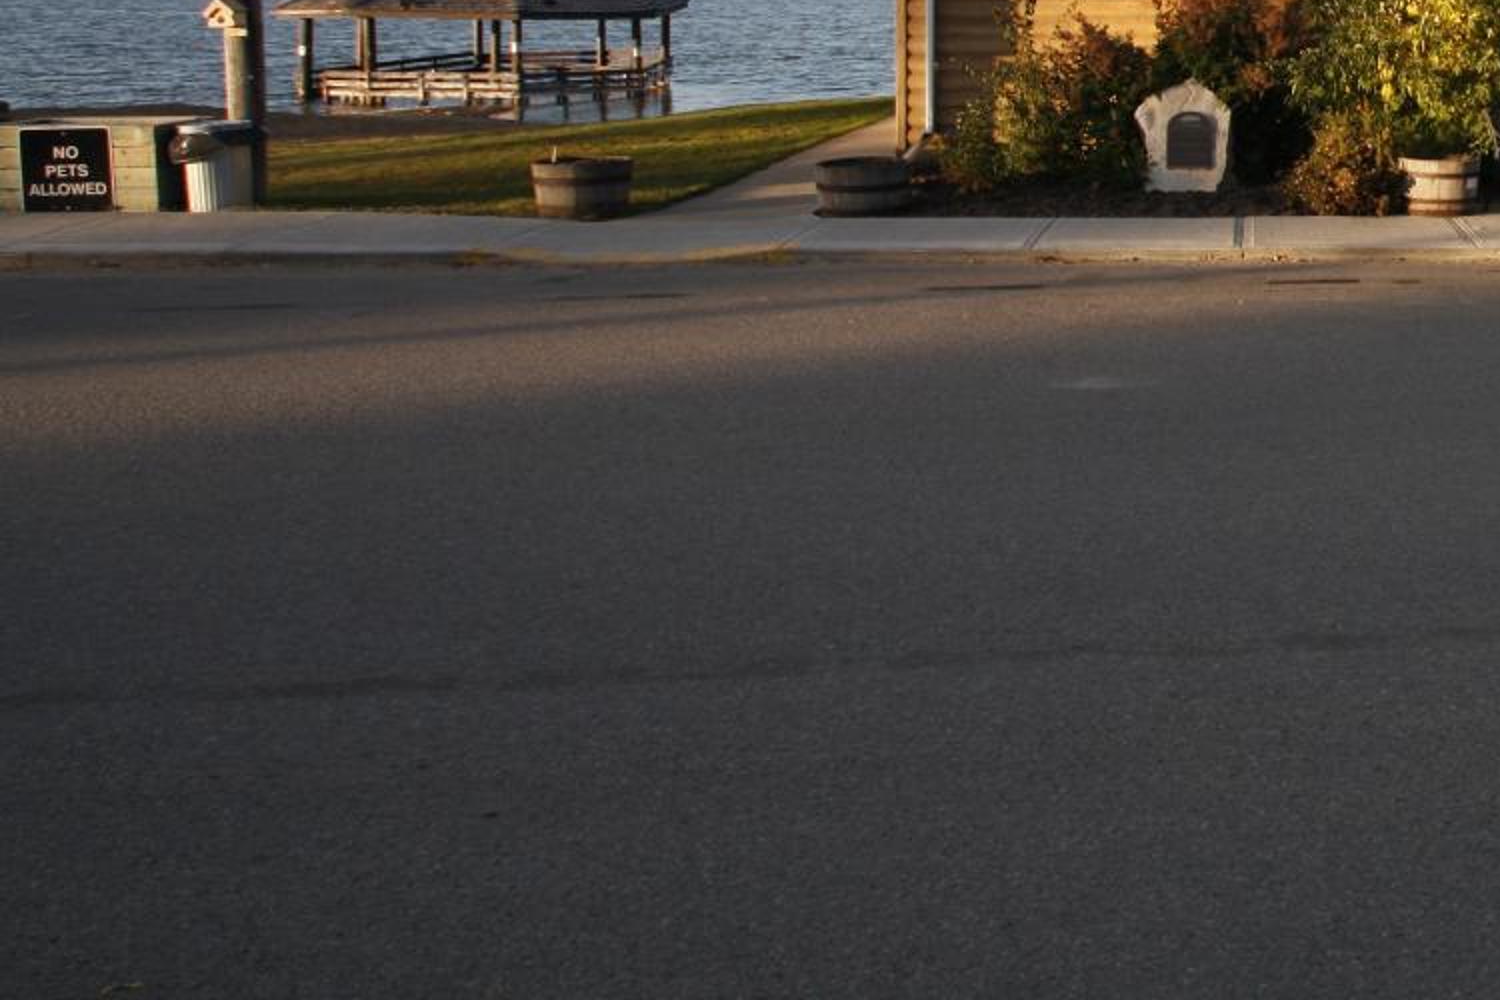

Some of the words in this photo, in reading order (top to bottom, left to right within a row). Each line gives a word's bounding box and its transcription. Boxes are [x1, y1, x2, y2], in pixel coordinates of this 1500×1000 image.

[53, 145, 79, 159] NO
[44, 163, 89, 178] PETS
[29, 182, 107, 196] ALLOWED
